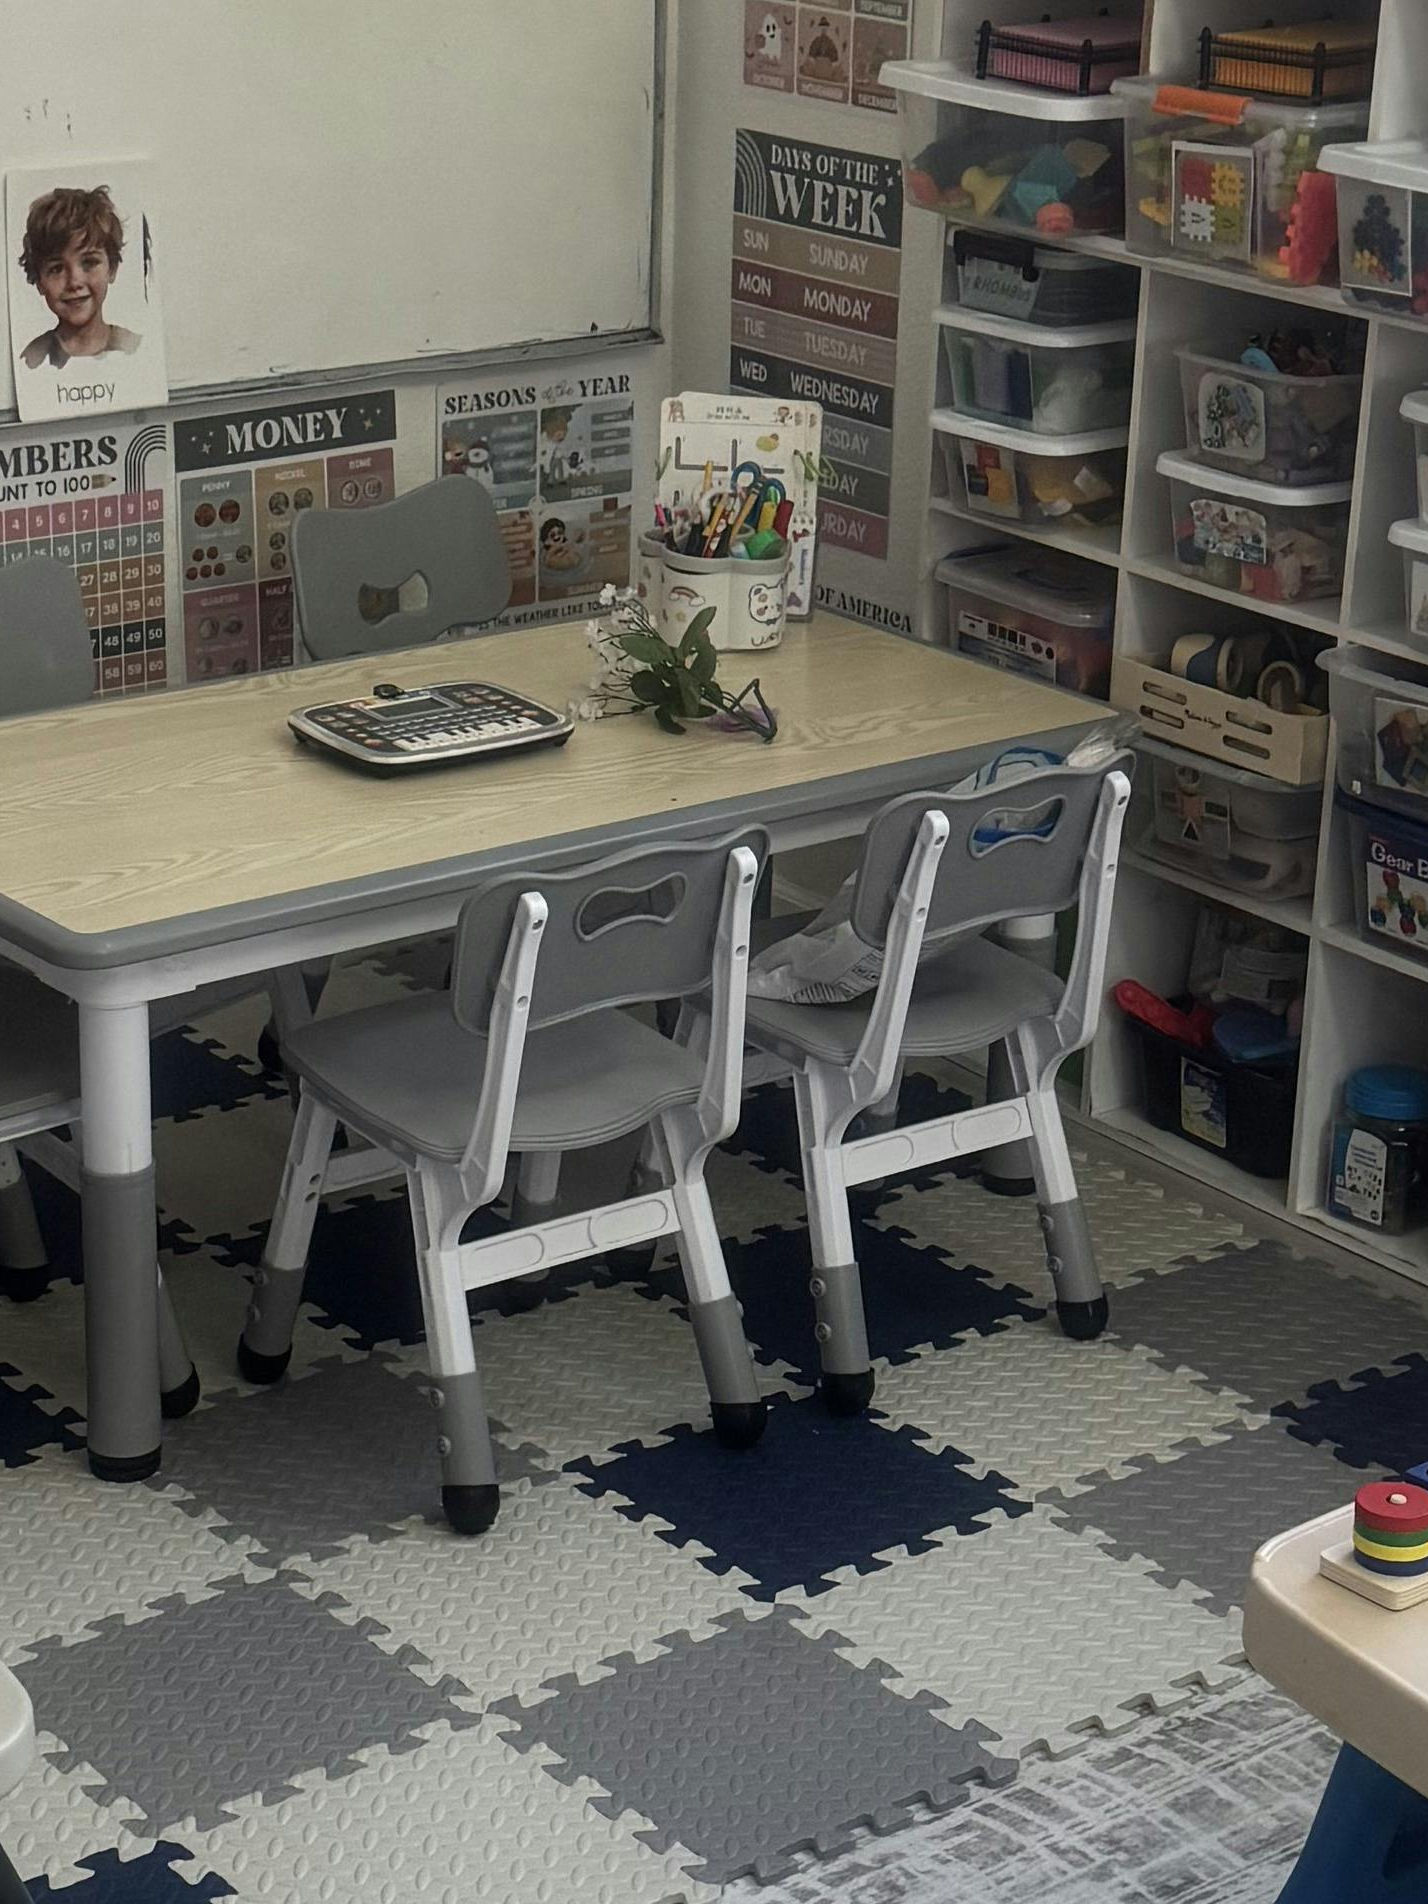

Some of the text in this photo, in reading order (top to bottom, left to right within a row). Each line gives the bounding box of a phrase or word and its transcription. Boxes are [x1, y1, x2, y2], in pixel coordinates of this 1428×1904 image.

[772, 144, 878, 185] DAYS OF THE
[771, 171, 887, 238] WEEK
[809, 243, 869, 274] SUNDAY
[804, 287, 872, 321] MONDAY
[740, 361, 768, 383] WED
[57, 380, 114, 406] happy
[444, 374, 631, 415] SEASONS YEAR
[790, 371, 880, 415] WEDNESDAY
[226, 407, 348, 455] MONEY
[36, 481, 56, 497] TO
[63, 474, 90, 494] 100
[839, 591, 912, 630] AMERICA
[1371, 841, 1414, 874] Gear
